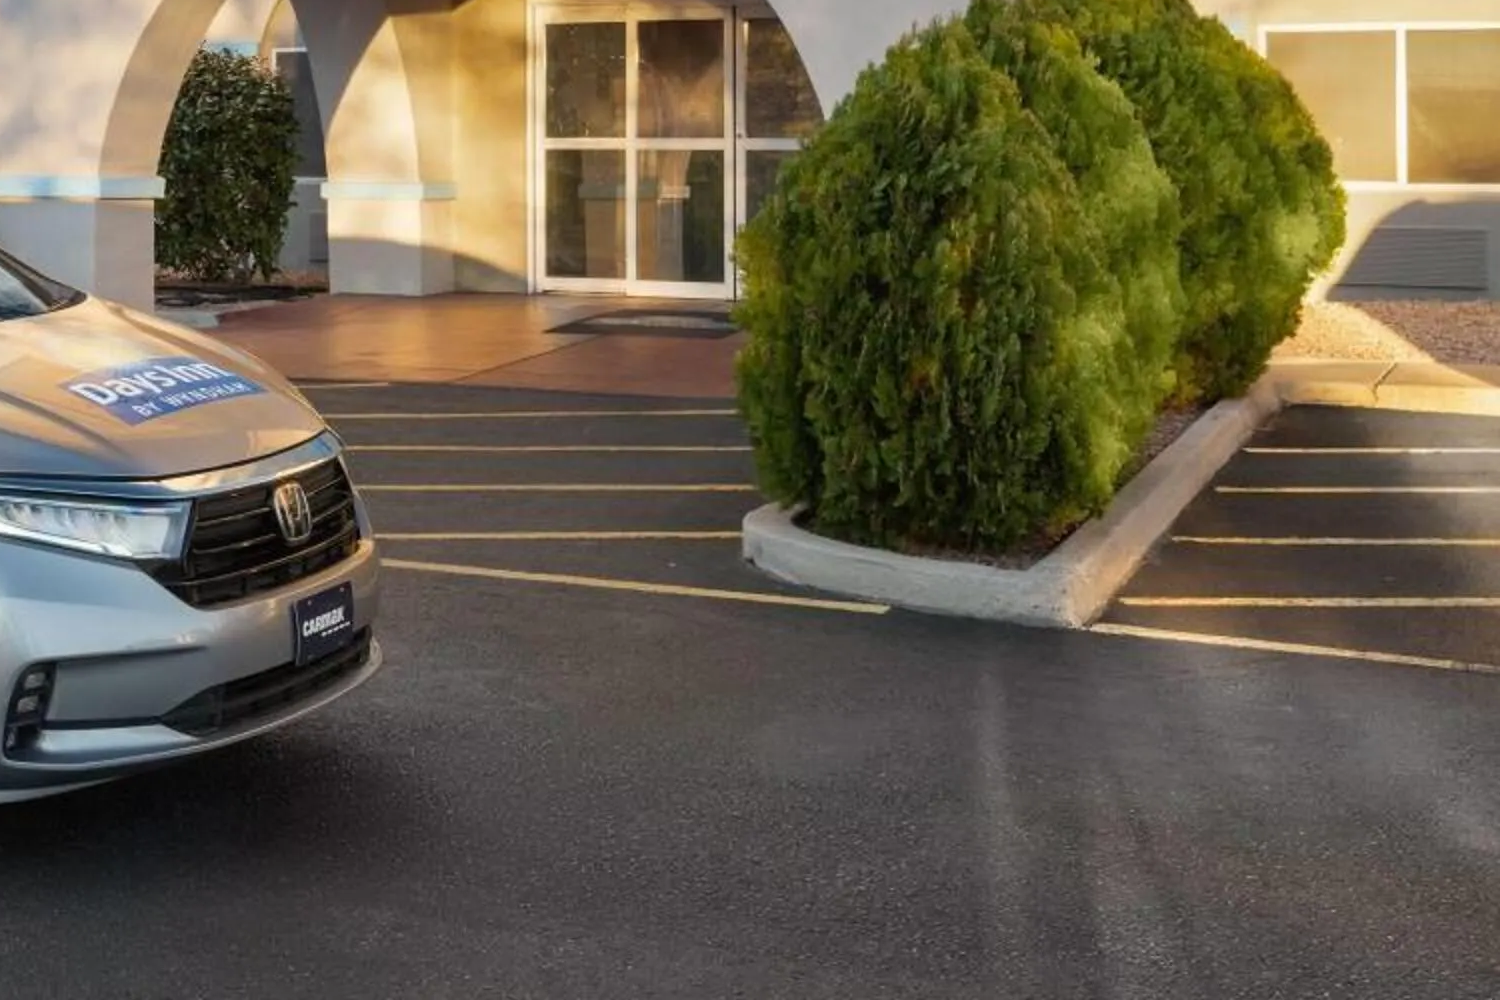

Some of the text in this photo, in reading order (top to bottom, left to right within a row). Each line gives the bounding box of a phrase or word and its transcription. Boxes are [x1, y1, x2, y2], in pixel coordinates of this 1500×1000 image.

[68, 361, 232, 405] Days Inn
[132, 403, 161, 417] BY
